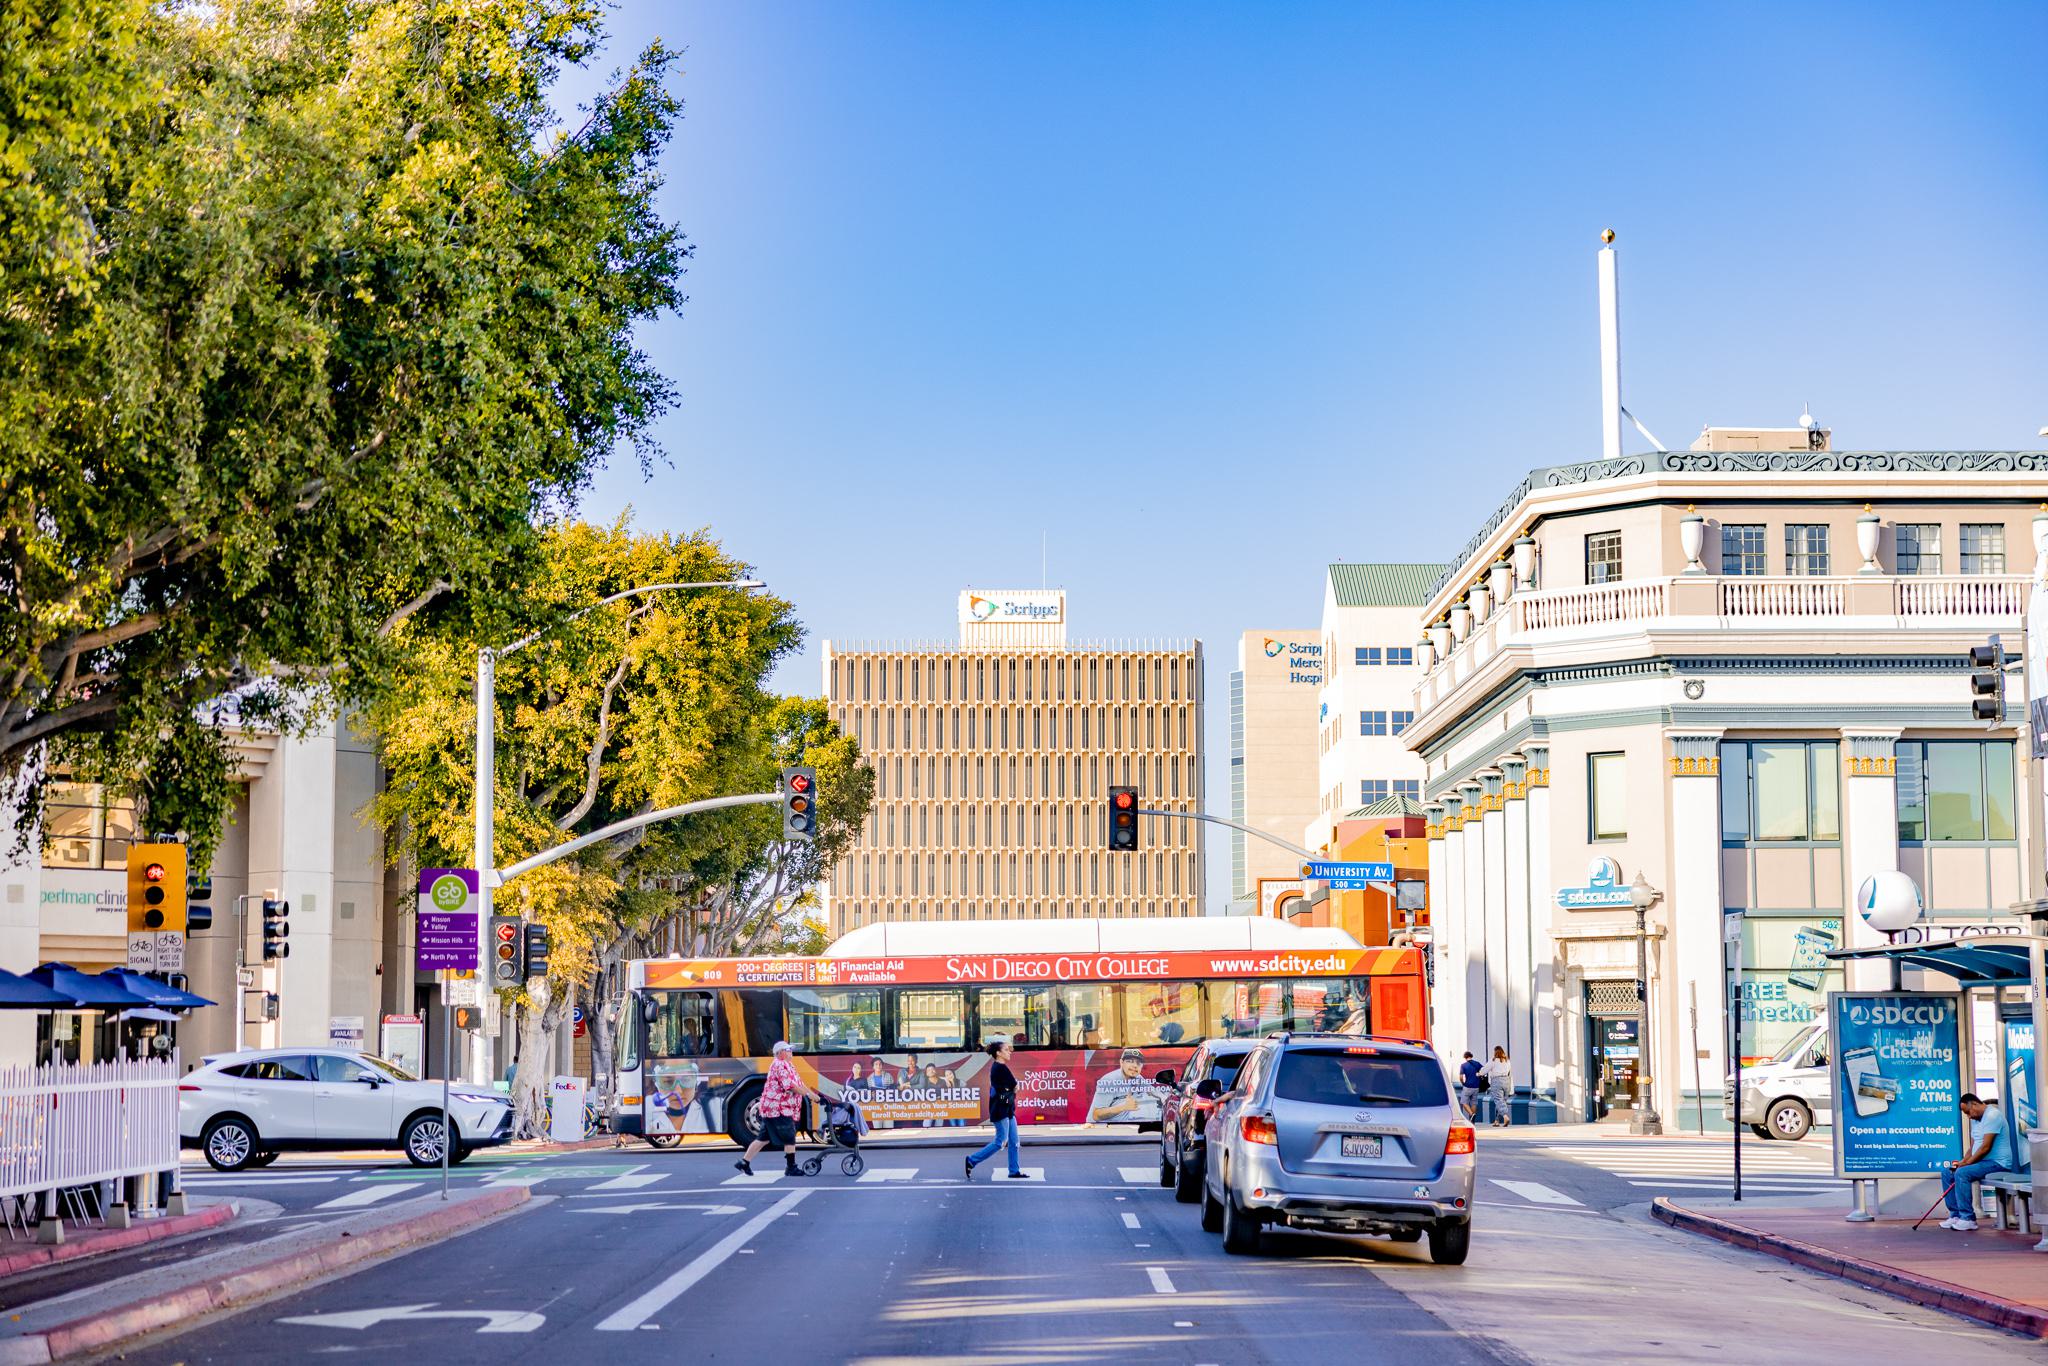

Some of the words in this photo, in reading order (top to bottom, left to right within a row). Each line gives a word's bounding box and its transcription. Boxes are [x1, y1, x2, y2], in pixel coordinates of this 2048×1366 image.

[1004, 602, 1058, 619] Scripps
[1315, 865, 1370, 877] UNIVERSITY
[437, 882, 462, 899] GO
[451, 936, 464, 944] Hills
[130, 956, 152, 964] SIGNAL
[1210, 956, 1346, 974] www.sdcity.edu
[736, 963, 761, 972] 200+
[763, 962, 803, 972] DEGREES
[841, 962, 889, 972] Financial
[890, 960, 904, 971] Aid
[946, 958, 986, 980] SAN
[993, 958, 1050, 980] DIEGO
[1055, 957, 1092, 980] CITY
[1096, 956, 1169, 978] COLLEGE
[704, 970, 722, 979] 809
[737, 973, 745, 982] &
[746, 972, 803, 982] CERTIFICATES
[818, 975, 837, 983] UNIT
[850, 971, 896, 982] Available
[1871, 1006, 1944, 1025] SDCCU
[1880, 1044, 1953, 1062] Checking
[1024, 1070, 1041, 1080] SAN
[1041, 1070, 1067, 1079] DIEGO
[555, 1082, 577, 1091] FedEx
[1017, 1080, 1031, 1091] ITY
[1031, 1079, 1076, 1092] COLLEGE
[1113, 1078, 1139, 1086] COLLEGE
[1909, 1079, 1952, 1091] 30,000
[1131, 1085, 1155, 1093] CAREER
[838, 1090, 871, 1103] YOU
[875, 1088, 937, 1103] BELONG
[940, 1087, 981, 1101] HERE
[1919, 1091, 1953, 1103] ATMs
[884, 1103, 906, 1111] Online,
[933, 1101, 948, 1109] Your
[948, 1100, 977, 1109] Schedule
[1017, 1096, 1068, 1109] sdcity.edu
[892, 1110, 914, 1119] Today:
[915, 1110, 948, 1118] sdcity.edu
[1911, 1105, 1953, 1113] surcharge-FREE
[1328, 1124, 1399, 1132] HIGHLANDER
[1849, 1126, 1874, 1136] Open
[1889, 1126, 1924, 1134] account
[1926, 1125, 1955, 1136] today!
[1344, 1143, 1379, 1155] 6JVV906
